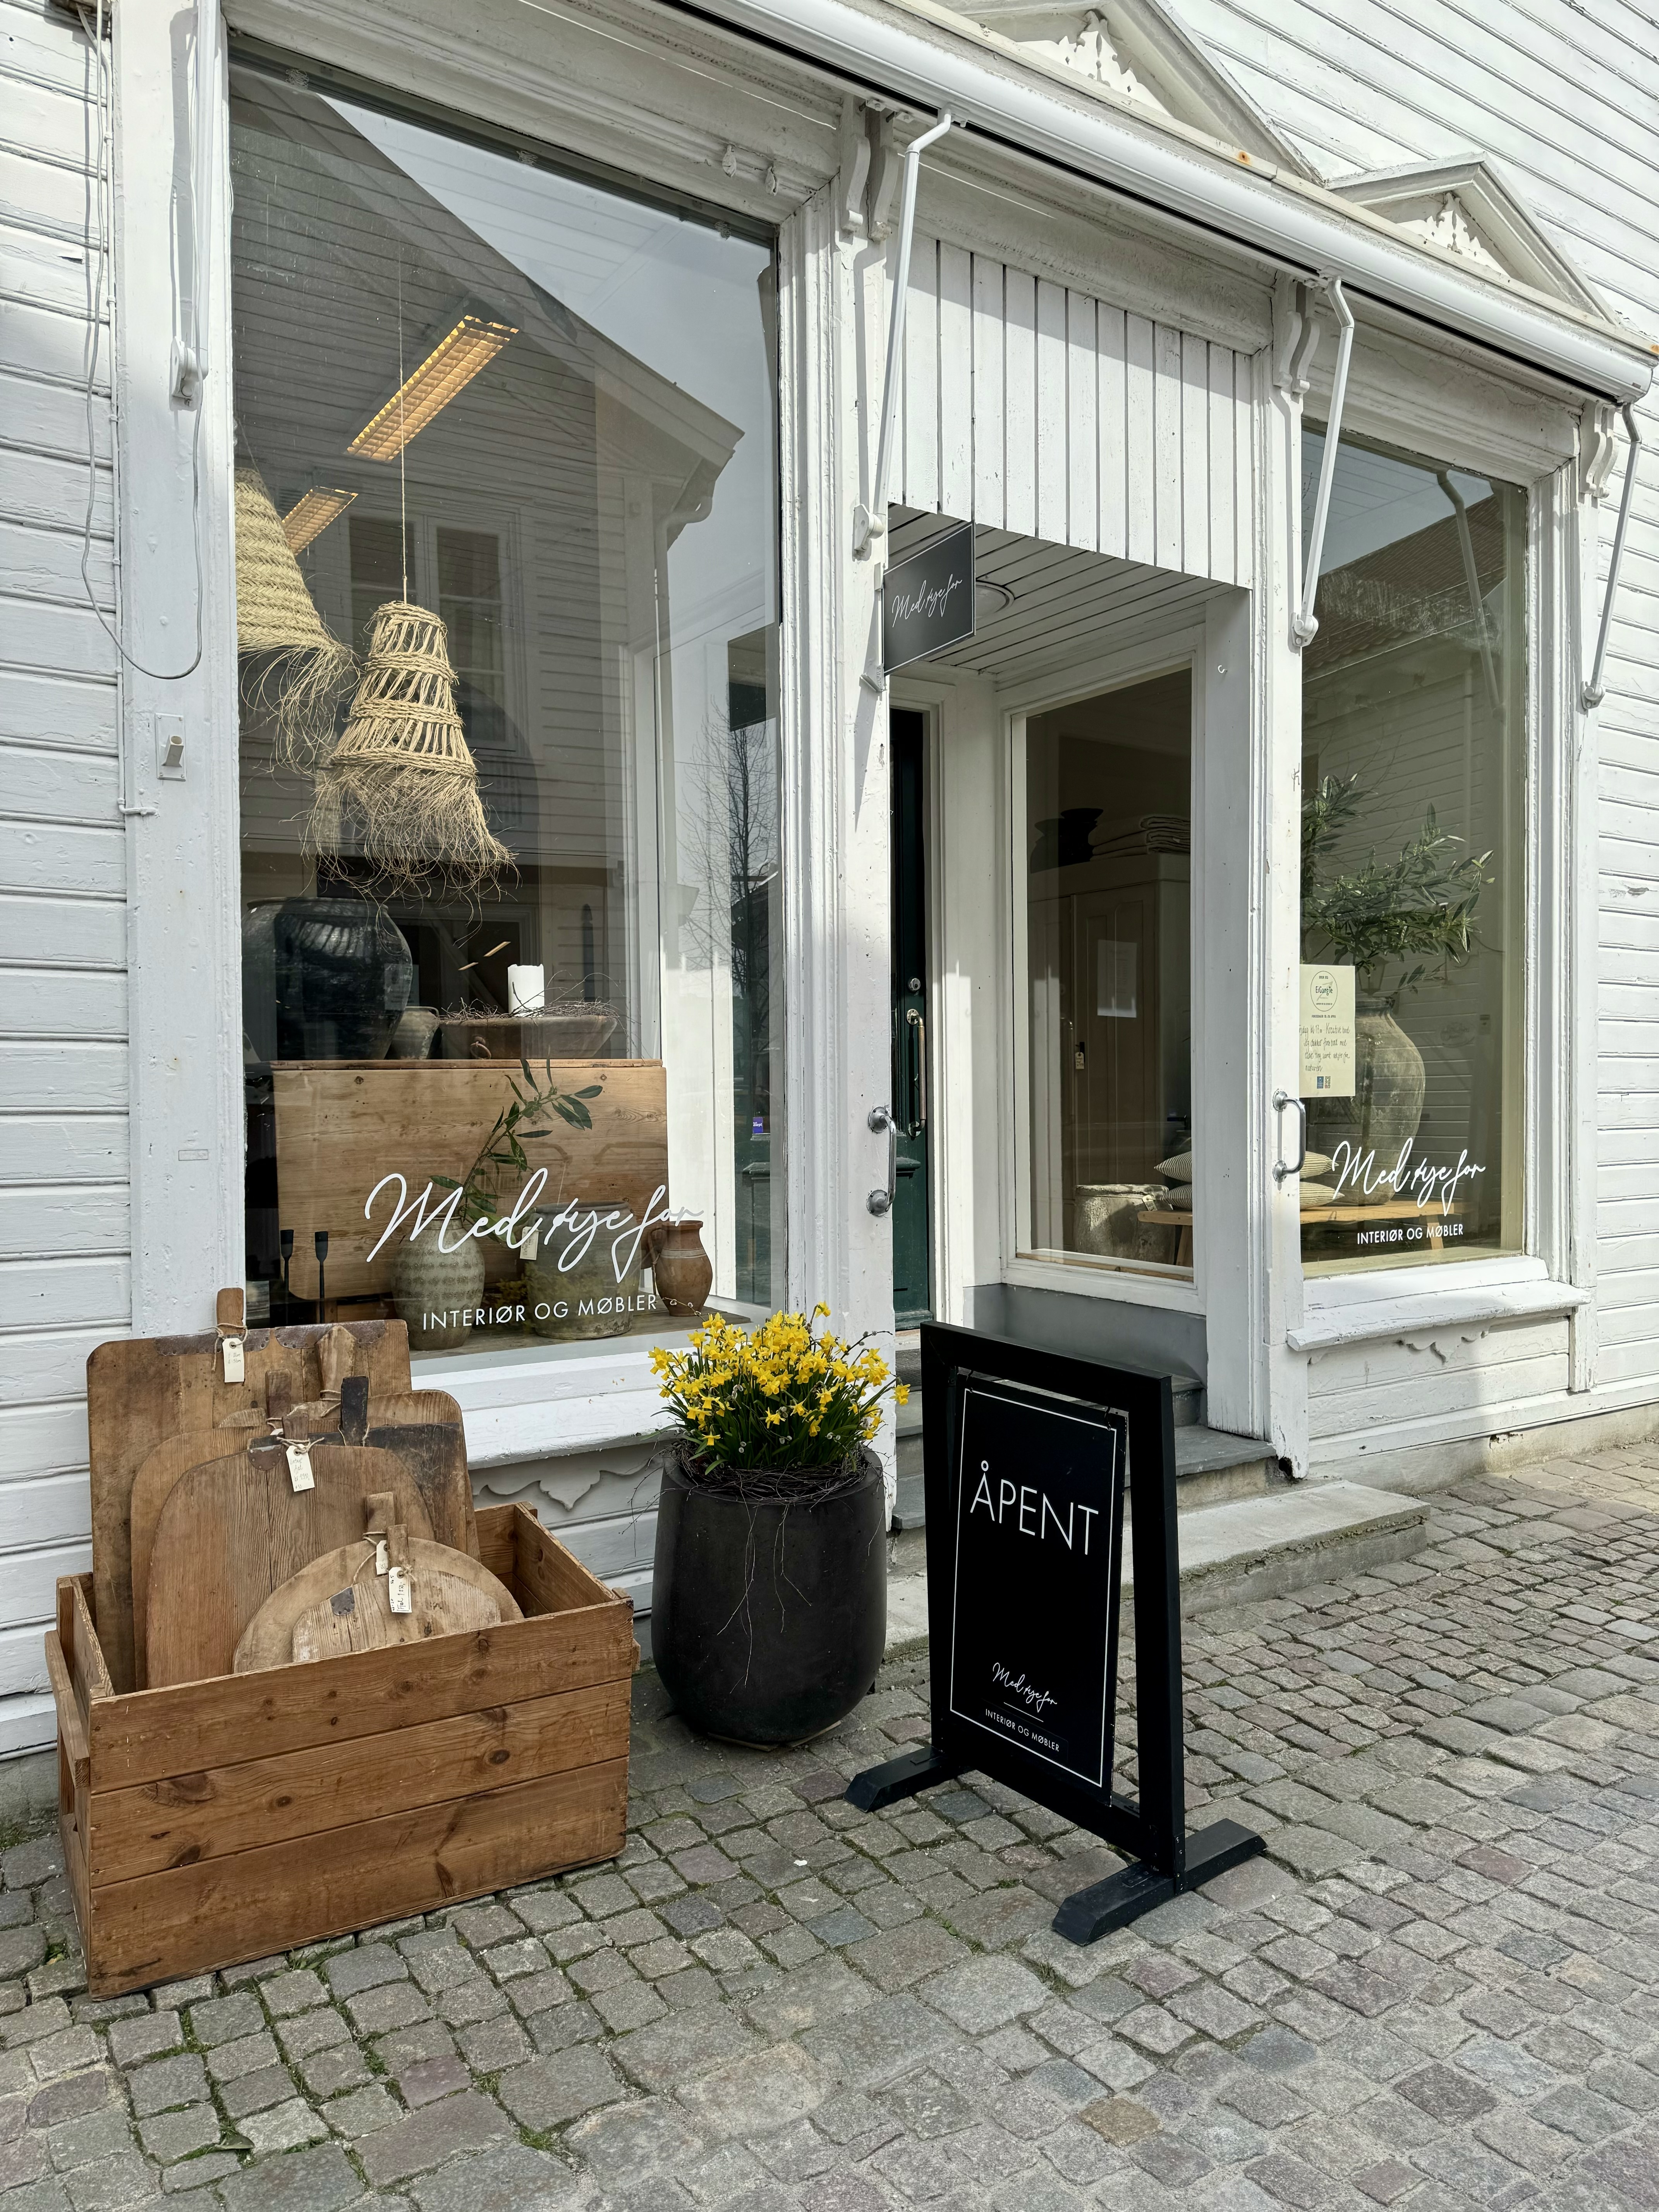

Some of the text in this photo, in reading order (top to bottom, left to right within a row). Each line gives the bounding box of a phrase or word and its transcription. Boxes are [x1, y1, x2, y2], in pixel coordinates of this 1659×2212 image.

[892, 580, 926, 628] Med
[1332, 1137, 1413, 1199] Med
[1441, 1149, 1486, 1217] for
[364, 1168, 548, 1262] Med
[611, 1185, 704, 1283] for
[1357, 1223, 1463, 1245] INTERIØR OG MØBLER
[423, 1294, 657, 1330] INTERIØR OG MØBLER
[970, 1460, 1099, 1555] ÅPENT
[993, 1662, 1025, 1693] Med
[1036, 1690, 1058, 1713] for
[985, 1708, 1059, 1752] INTERIØR OG MØBLER
